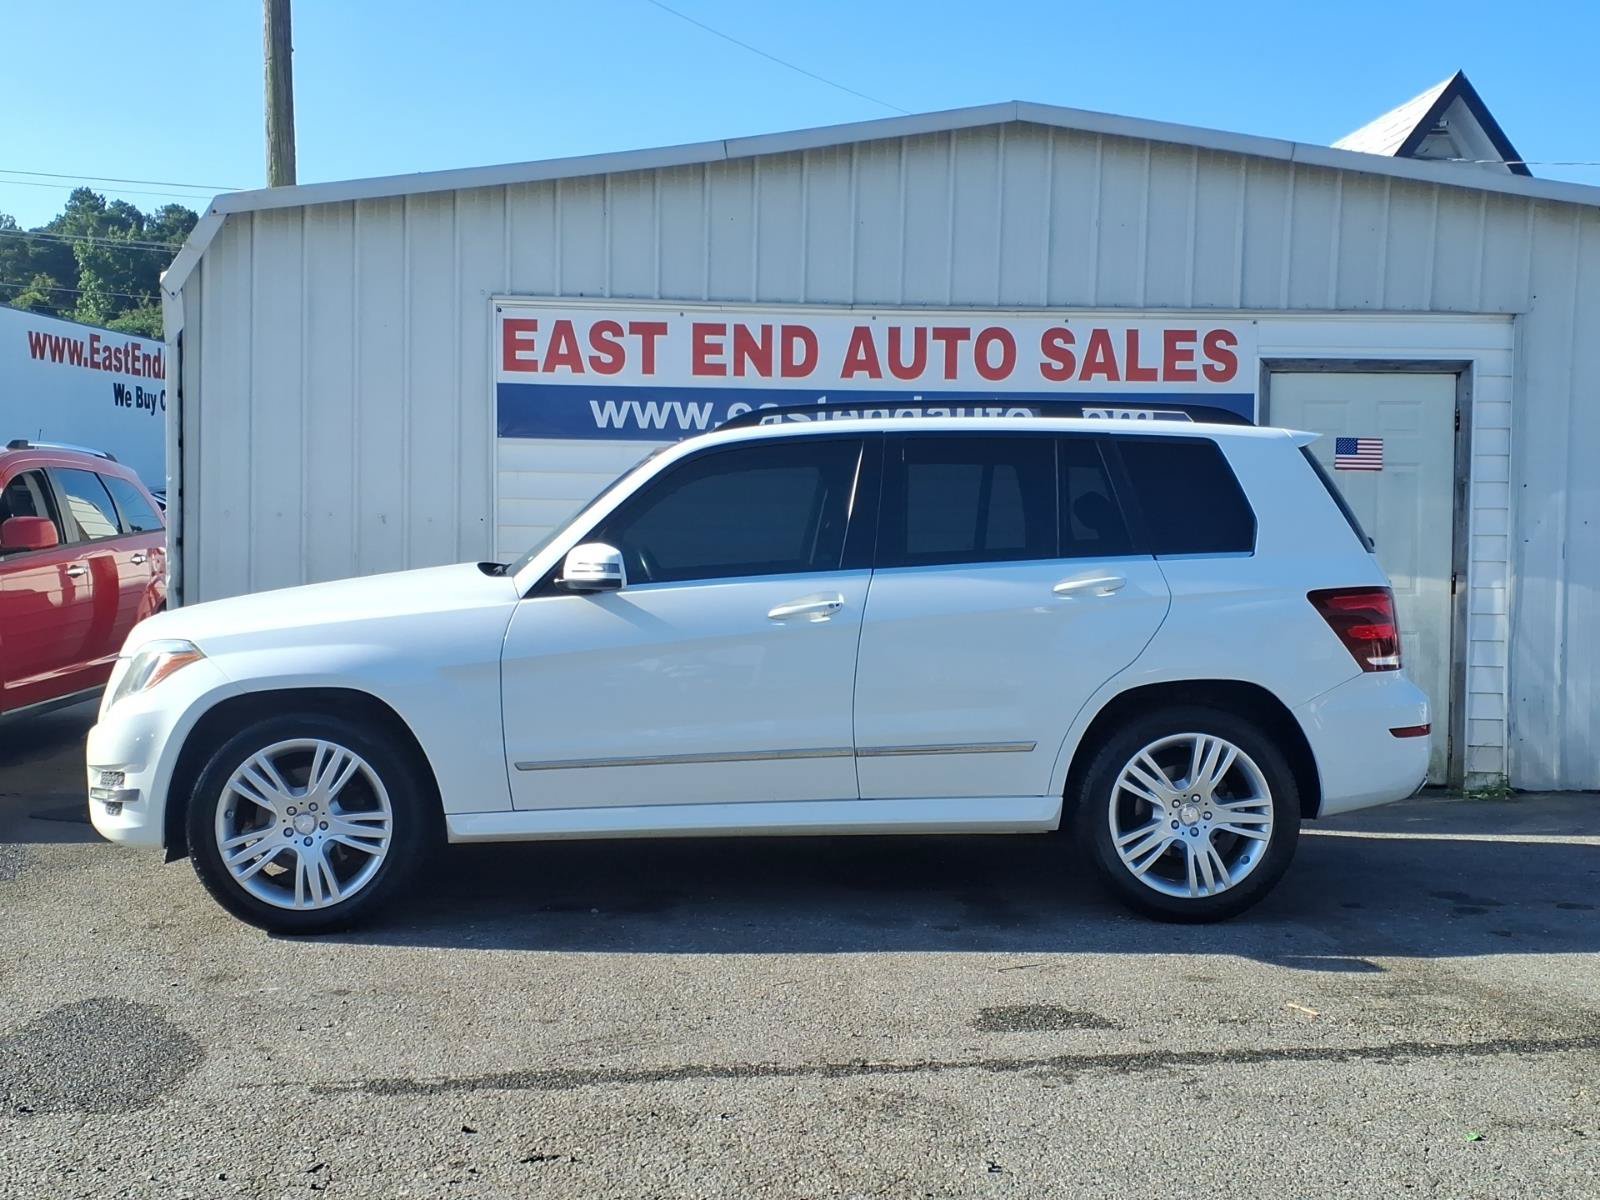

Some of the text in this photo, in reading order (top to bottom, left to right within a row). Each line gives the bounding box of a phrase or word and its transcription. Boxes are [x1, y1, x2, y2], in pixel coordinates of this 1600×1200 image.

[502, 318, 1239, 383] EAST END AUTO SALES
[113, 382, 132, 408] We
[135, 386, 157, 416] Buy
